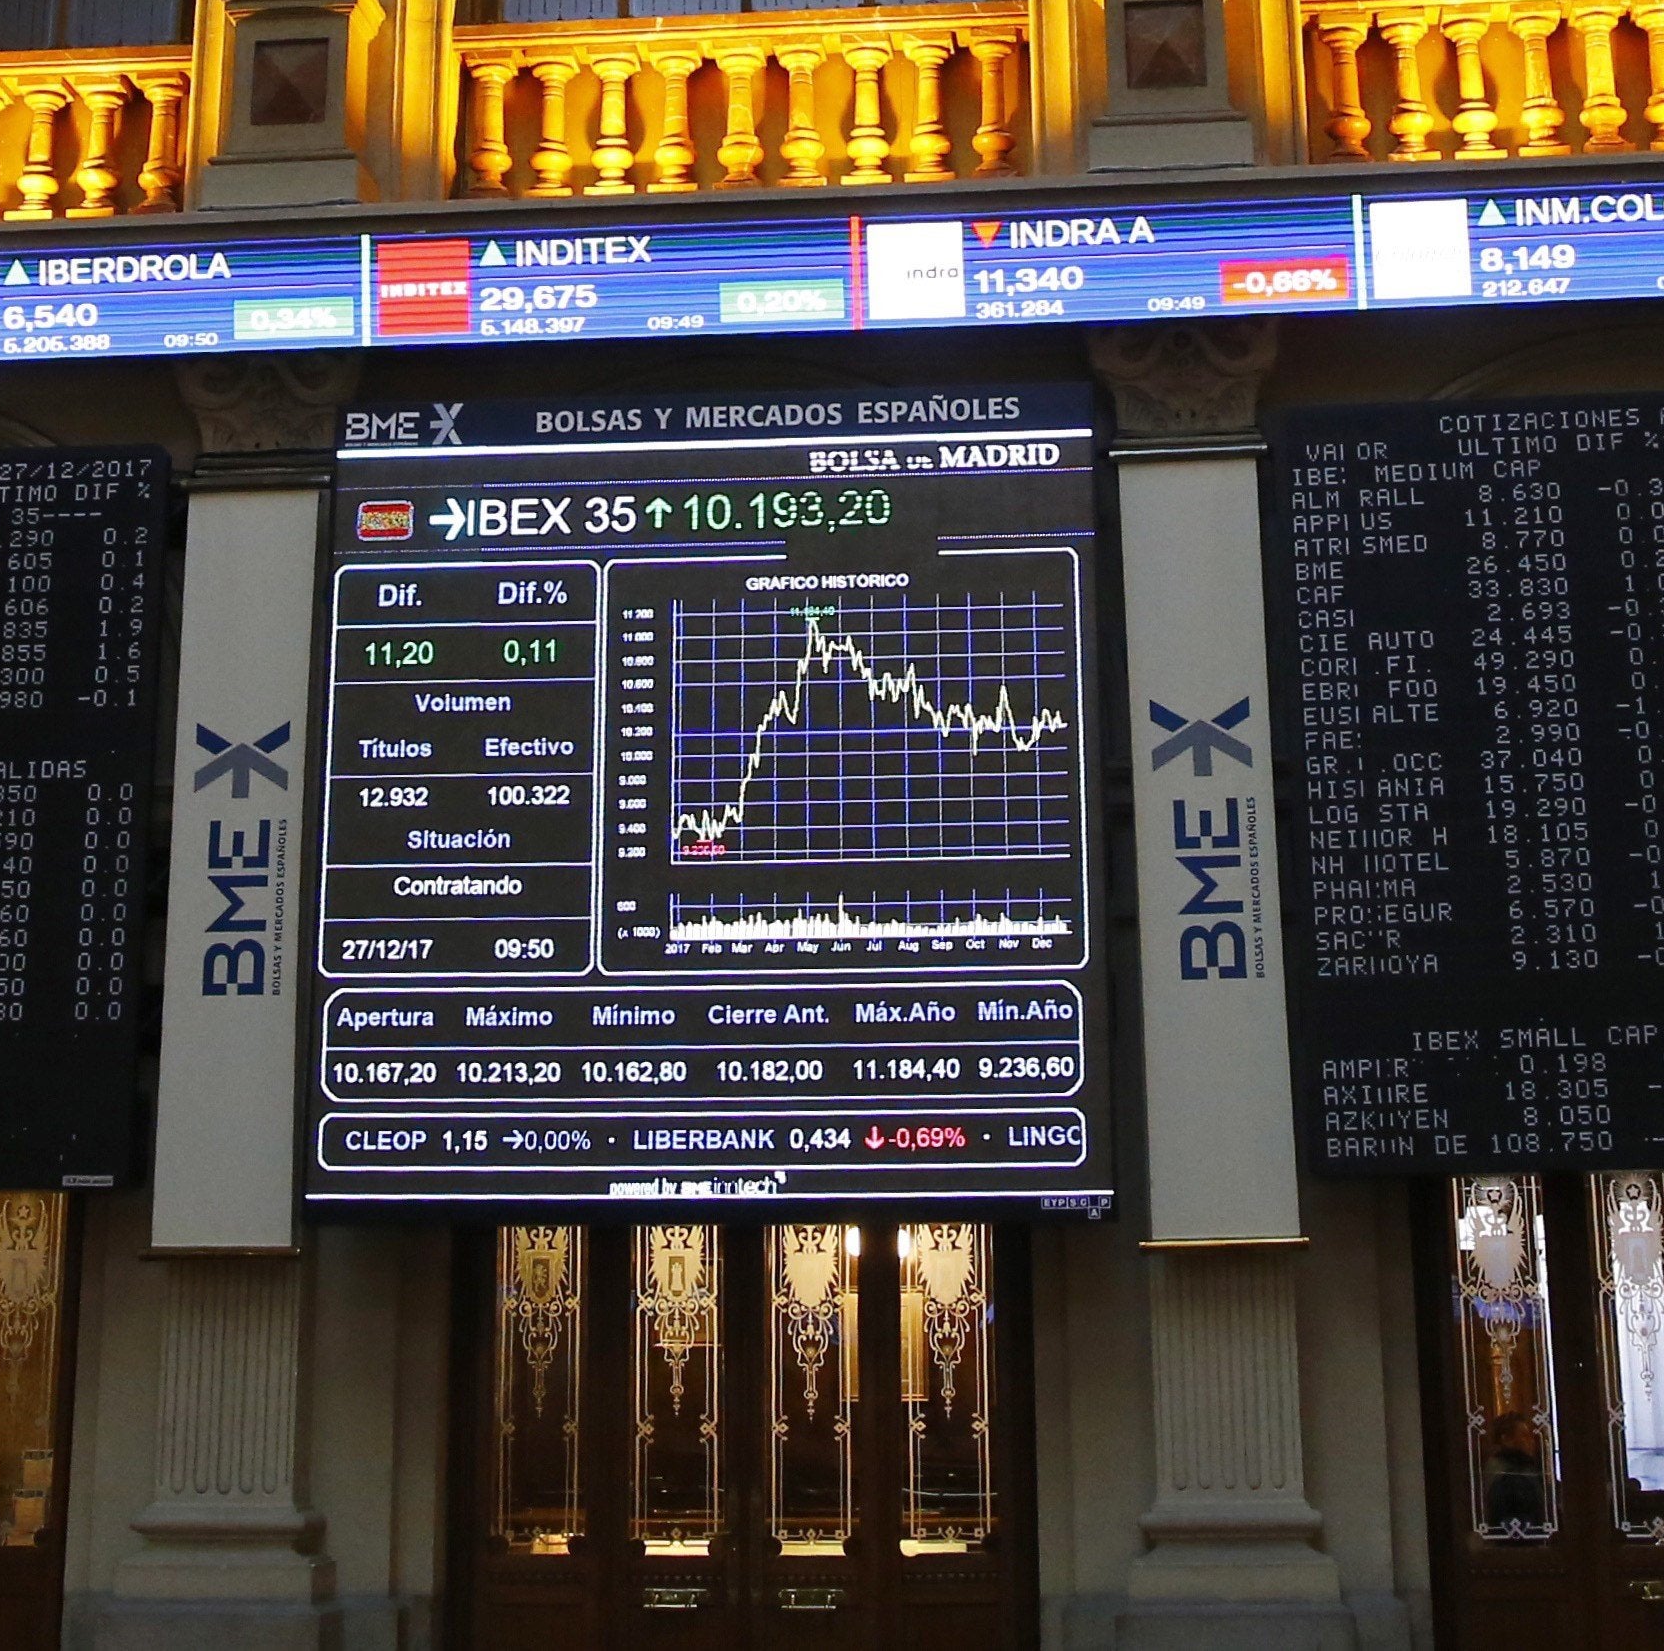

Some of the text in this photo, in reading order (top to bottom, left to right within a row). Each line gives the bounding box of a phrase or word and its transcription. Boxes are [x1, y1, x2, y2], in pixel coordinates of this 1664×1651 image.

[1010, 217, 1156, 249] INDRA A
[516, 236, 652, 267] INDITEX
[1479, 244, 1576, 275] 8,149
[38, 253, 231, 286] IBERDROLA
[906, 266, 959, 279] indra
[973, 266, 1084, 296] 11,340
[380, 282, 468, 298] INDITEX
[480, 285, 597, 314] 29,675
[1482, 279, 1570, 298] 212.647
[3, 303, 99, 332] 6,540
[648, 314, 705, 331] 09:49
[164, 332, 218, 349] 09:50
[345, 411, 420, 441] BME
[535, 394, 1022, 436] BOLSAS Y MERCADOS ESPAÑOLES
[1439, 408, 1640, 435] COTIZACIONES
[809, 449, 901, 472] BOLSA
[939, 443, 1060, 468] MADRID
[467, 490, 893, 538] IBEX 35 10.193,20
[377, 580, 568, 607] Dif. Dif.%
[365, 639, 557, 668] 11,20 0,11
[359, 738, 574, 758] Títulos Efectivo
[359, 785, 570, 807] 12.932 100.322
[407, 829, 511, 848] Situación
[1247, 797, 1259, 858] ESPAÑOLES
[276, 819, 287, 878] ESPAÑOLES
[393, 876, 522, 895] Contratando
[1173, 798, 1248, 980] BME
[1250, 861, 1262, 923] MERCADOS
[202, 819, 271, 996] BME
[274, 881, 284, 942] MERCADOS
[342, 938, 555, 960] 27/12/17 09:50
[665, 937, 1052, 955] 2017 Feb Mar Apr May Jun Jul Aug Sep Oct Nov Dec
[1254, 936, 1264, 978] BOLSAS
[273, 954, 282, 996] BOLSAS
[336, 1000, 1073, 1031] Apertura Máximo Mínimo Cierre Ant. Máx.Año Mín.Año
[333, 1057, 1073, 1085] 10.167,20 10.213,20 10.162,80 10.182,00 11.184,40 9.236,60
[345, 1127, 965, 1154] CLEOP 1,15 0,00% LIBERBANK 0,434 -0,69%
